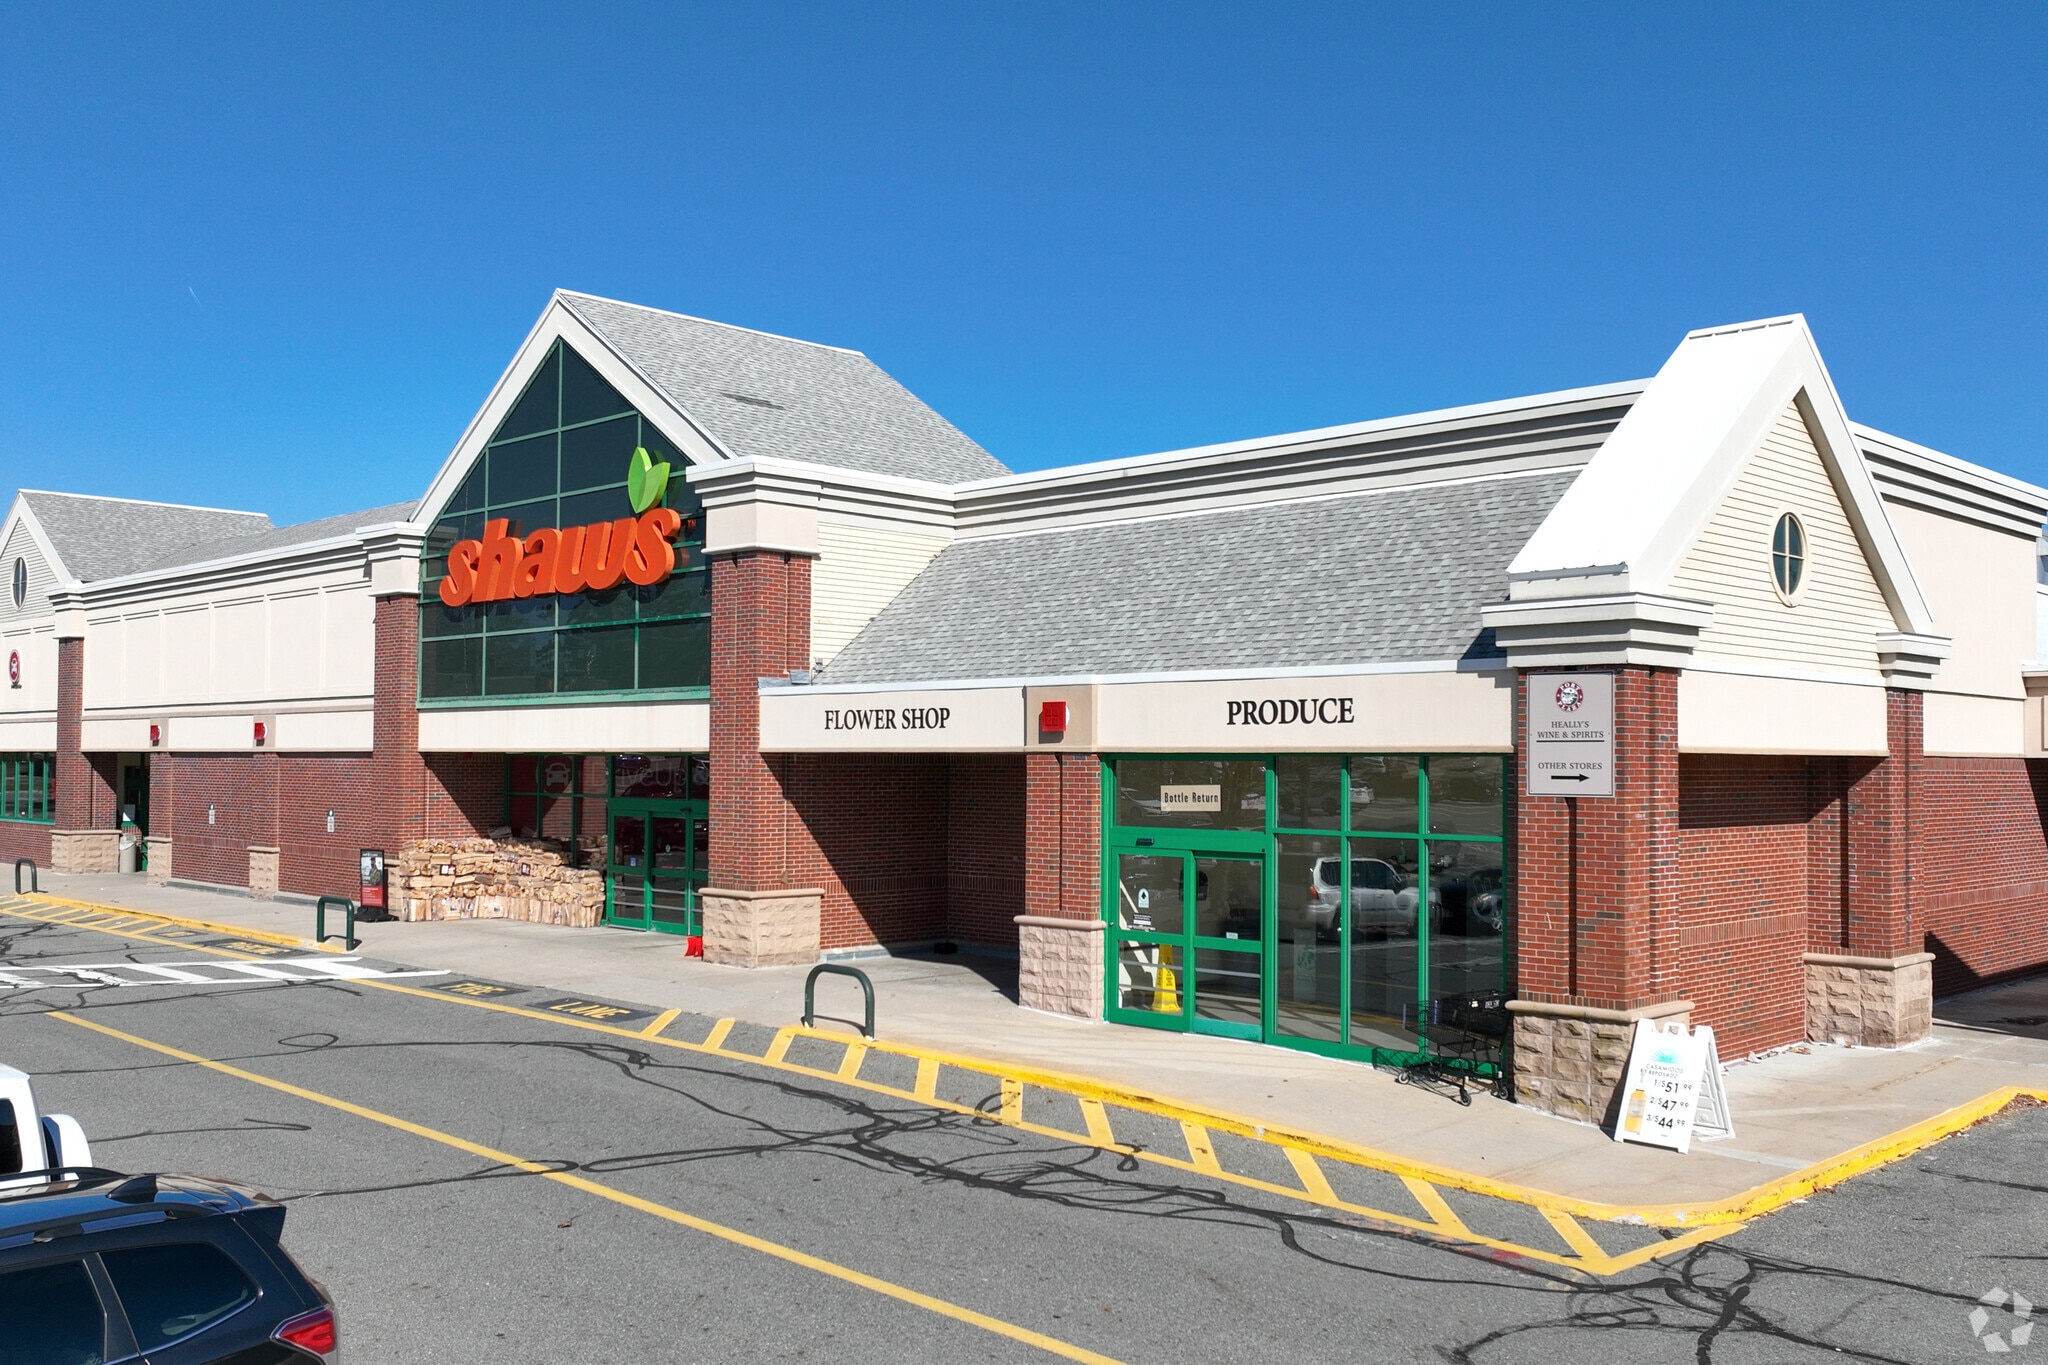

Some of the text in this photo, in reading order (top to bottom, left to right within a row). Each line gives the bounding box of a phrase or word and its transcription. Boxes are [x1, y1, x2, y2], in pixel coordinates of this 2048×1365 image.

[1560, 682, 1580, 690] PORT
[1226, 698, 1355, 725] PRODUCE
[824, 707, 950, 730] FLOWER SHOP
[1537, 731, 1605, 739] WINE & SPIRITS
[1538, 762, 1603, 770] OTHER STORES
[1164, 792, 1219, 803] Bottle Return
[549, 1001, 631, 1019] LANE
[1645, 1063, 1684, 1074] CASAMIGOS
